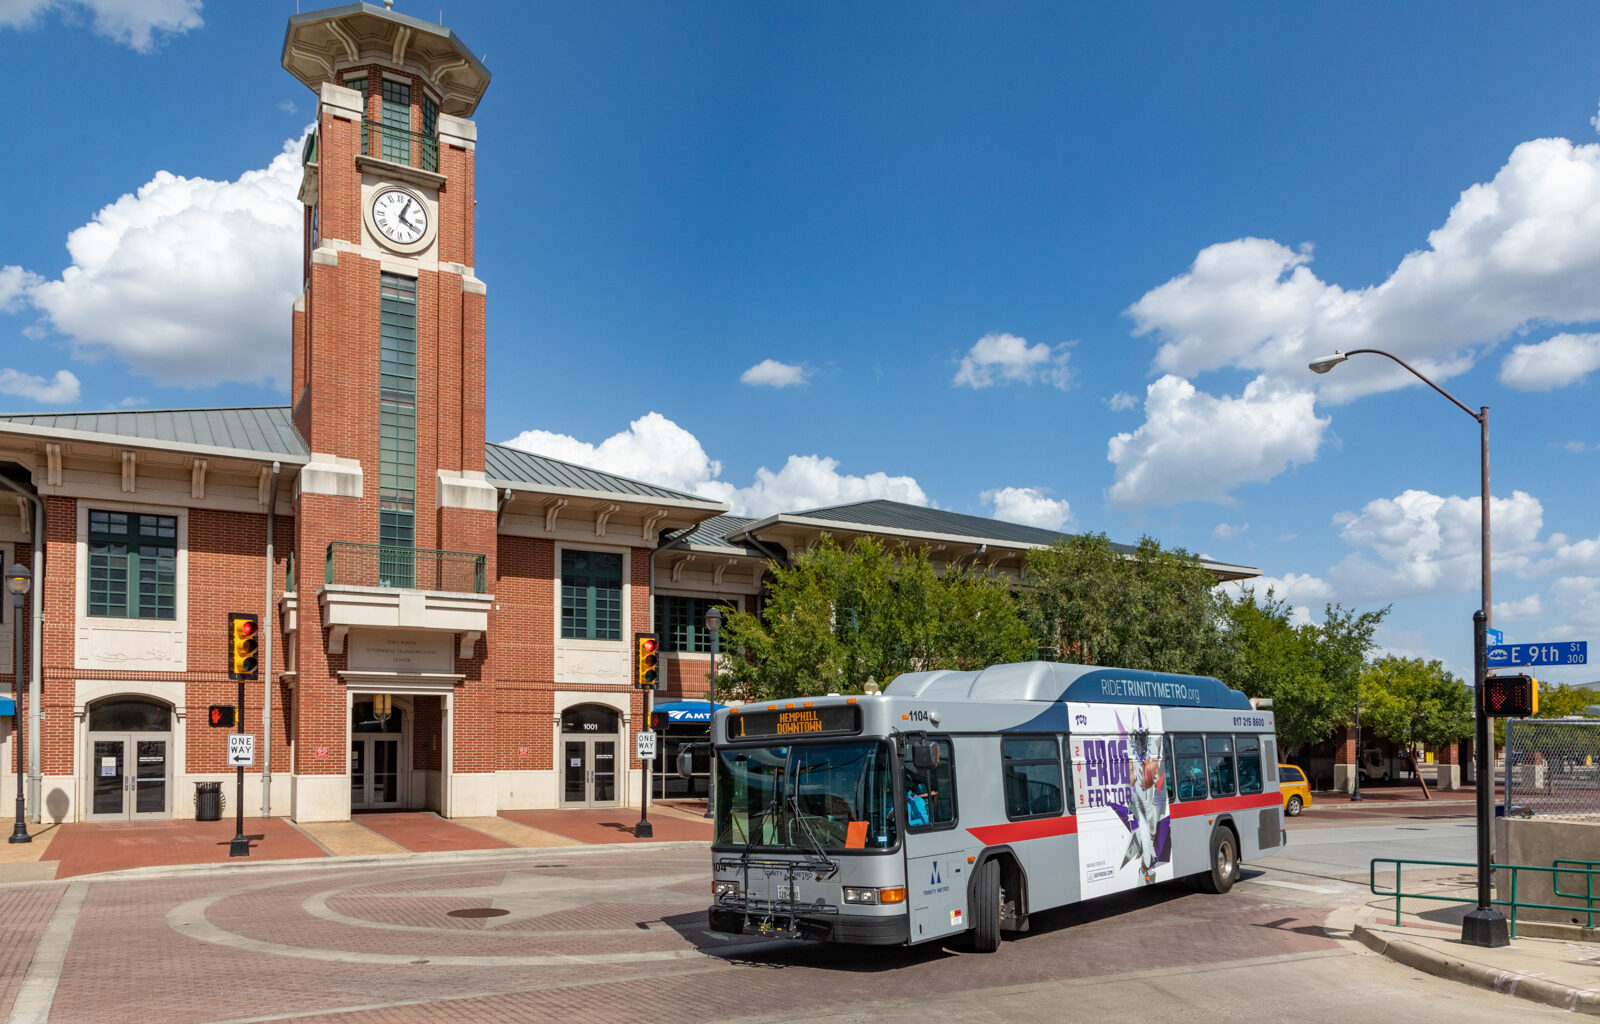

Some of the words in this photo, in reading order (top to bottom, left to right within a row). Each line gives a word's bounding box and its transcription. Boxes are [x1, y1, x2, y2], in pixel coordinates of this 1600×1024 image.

[1511, 647, 1521, 663] E
[1528, 646, 1560, 662] 9th
[1570, 643, 1580, 652] St
[1567, 654, 1584, 663] 300
[1101, 679, 1200, 704] RIDETRINITYMETRO.org
[780, 711, 818, 722] HEMPHILL
[909, 710, 928, 721] 1104
[1075, 714, 1088, 726] TCU
[1233, 717, 1242, 726] 817
[1243, 717, 1251, 726] 215
[1253, 717, 1265, 727] 8600
[740, 716, 746, 737] 1
[777, 720, 822, 734] DOWNTOWN
[231, 737, 252, 745] ONE
[231, 746, 252, 754] WAY
[1083, 739, 1131, 787] FROG
[1075, 746, 1085, 805] 2019
[1088, 786, 1134, 808] FACTOR
